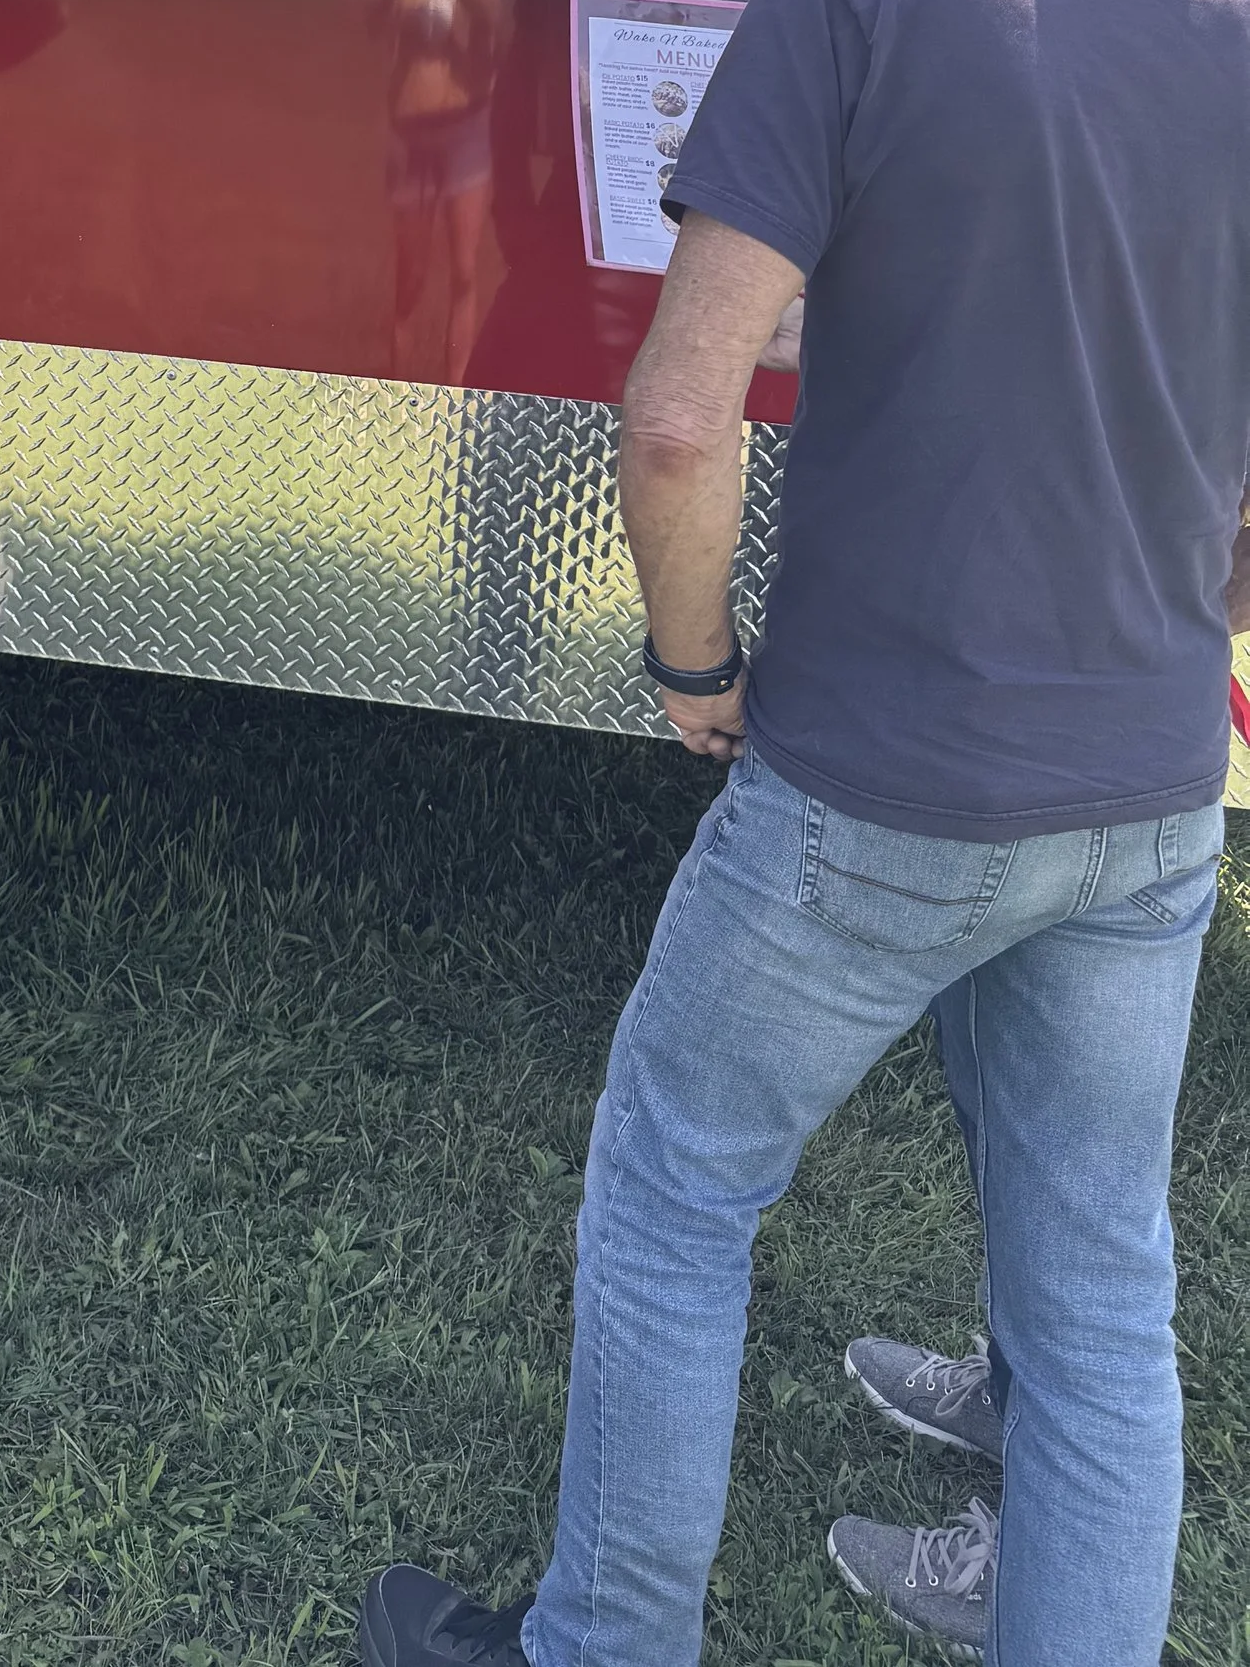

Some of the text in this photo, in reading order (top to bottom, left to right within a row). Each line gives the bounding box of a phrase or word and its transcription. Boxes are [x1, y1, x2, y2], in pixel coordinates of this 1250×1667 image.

[614, 28, 726, 50] Wake N Baked
[656, 49, 715, 68] MENU
[636, 74, 649, 82] $15
